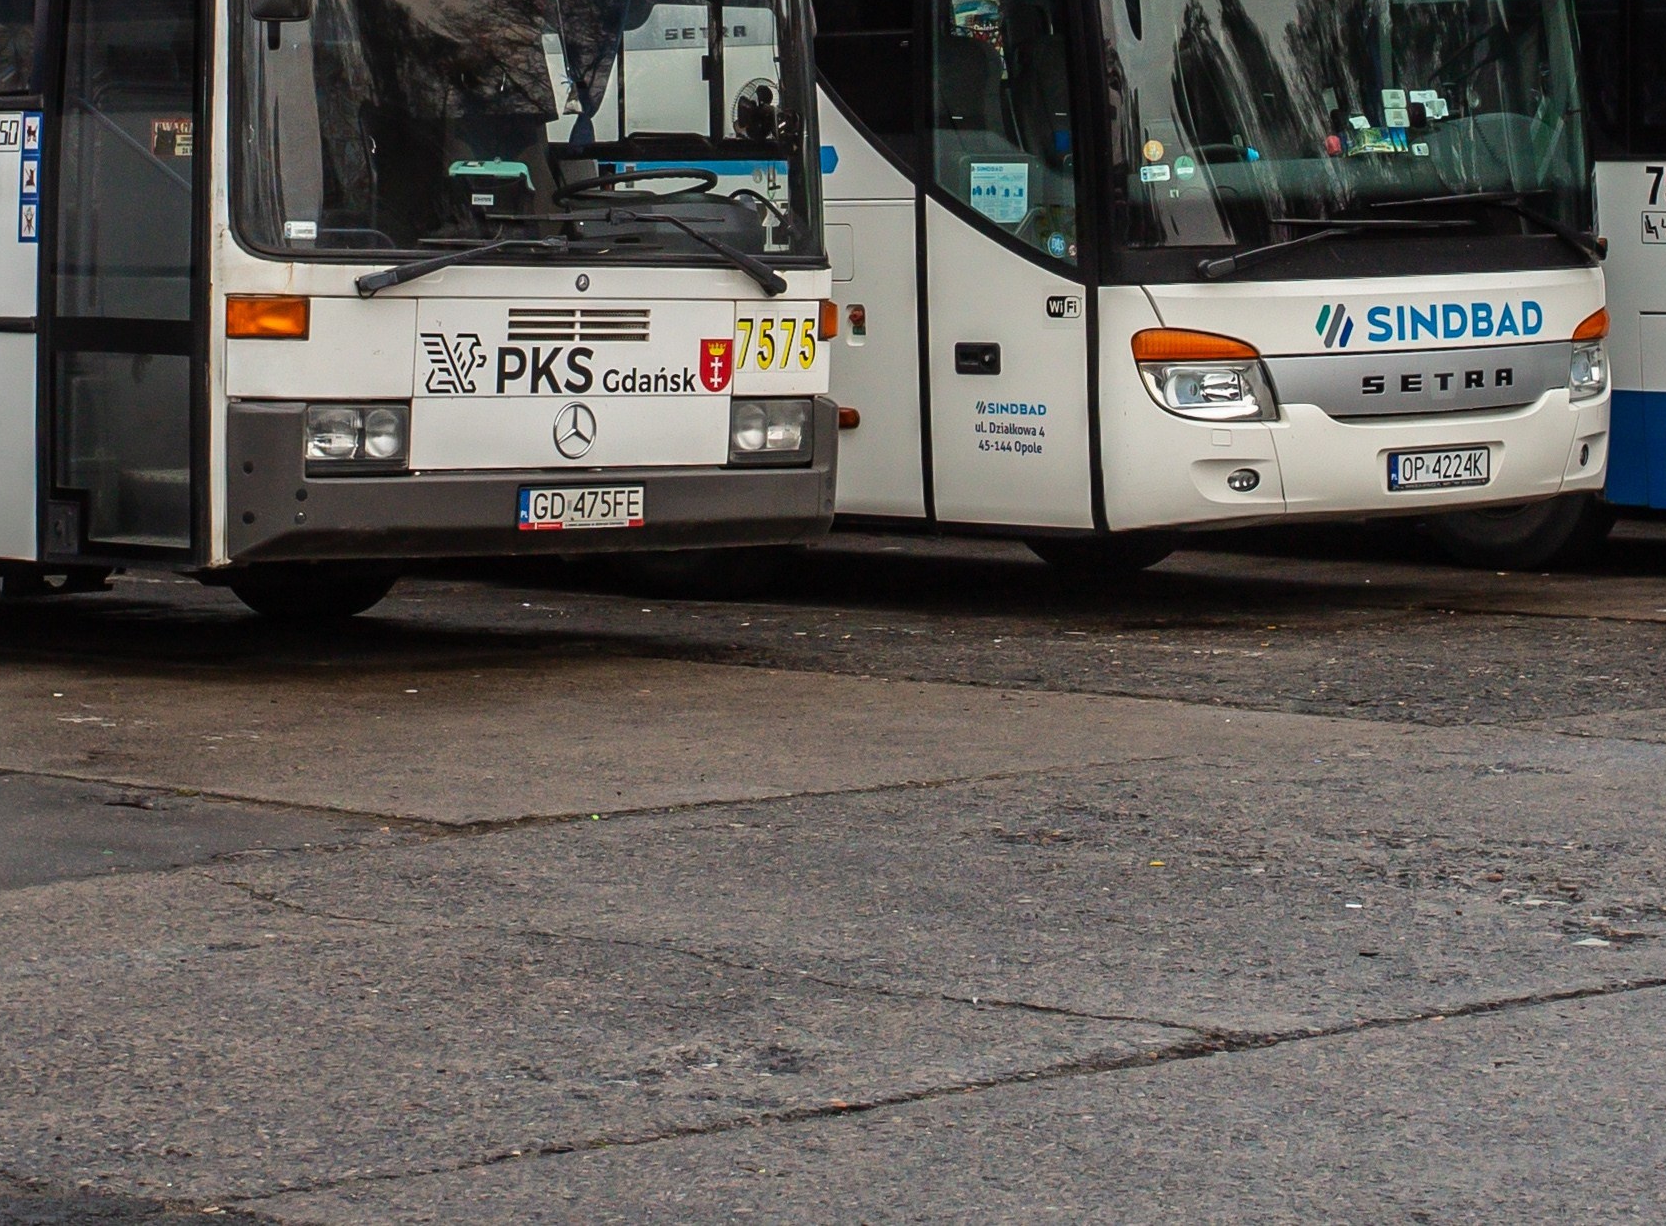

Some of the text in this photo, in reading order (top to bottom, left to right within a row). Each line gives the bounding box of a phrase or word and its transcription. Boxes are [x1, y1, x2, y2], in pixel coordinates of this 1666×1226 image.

[1048, 300, 1078, 314] WiFi
[1366, 300, 1544, 343] SINDBAD
[735, 317, 817, 371] 7575
[495, 346, 697, 395] PKS Gdańsk
[1361, 367, 1514, 395] SETRA
[987, 402, 1047, 416] SINDBAD
[975, 421, 1046, 437] ul. Działkowa 4
[978, 440, 1043, 456] 45-144 Opole
[1402, 456, 1425, 482] OP
[1432, 451, 1483, 480] 4224K
[533, 491, 566, 520] GD
[573, 489, 640, 519] 475FE
